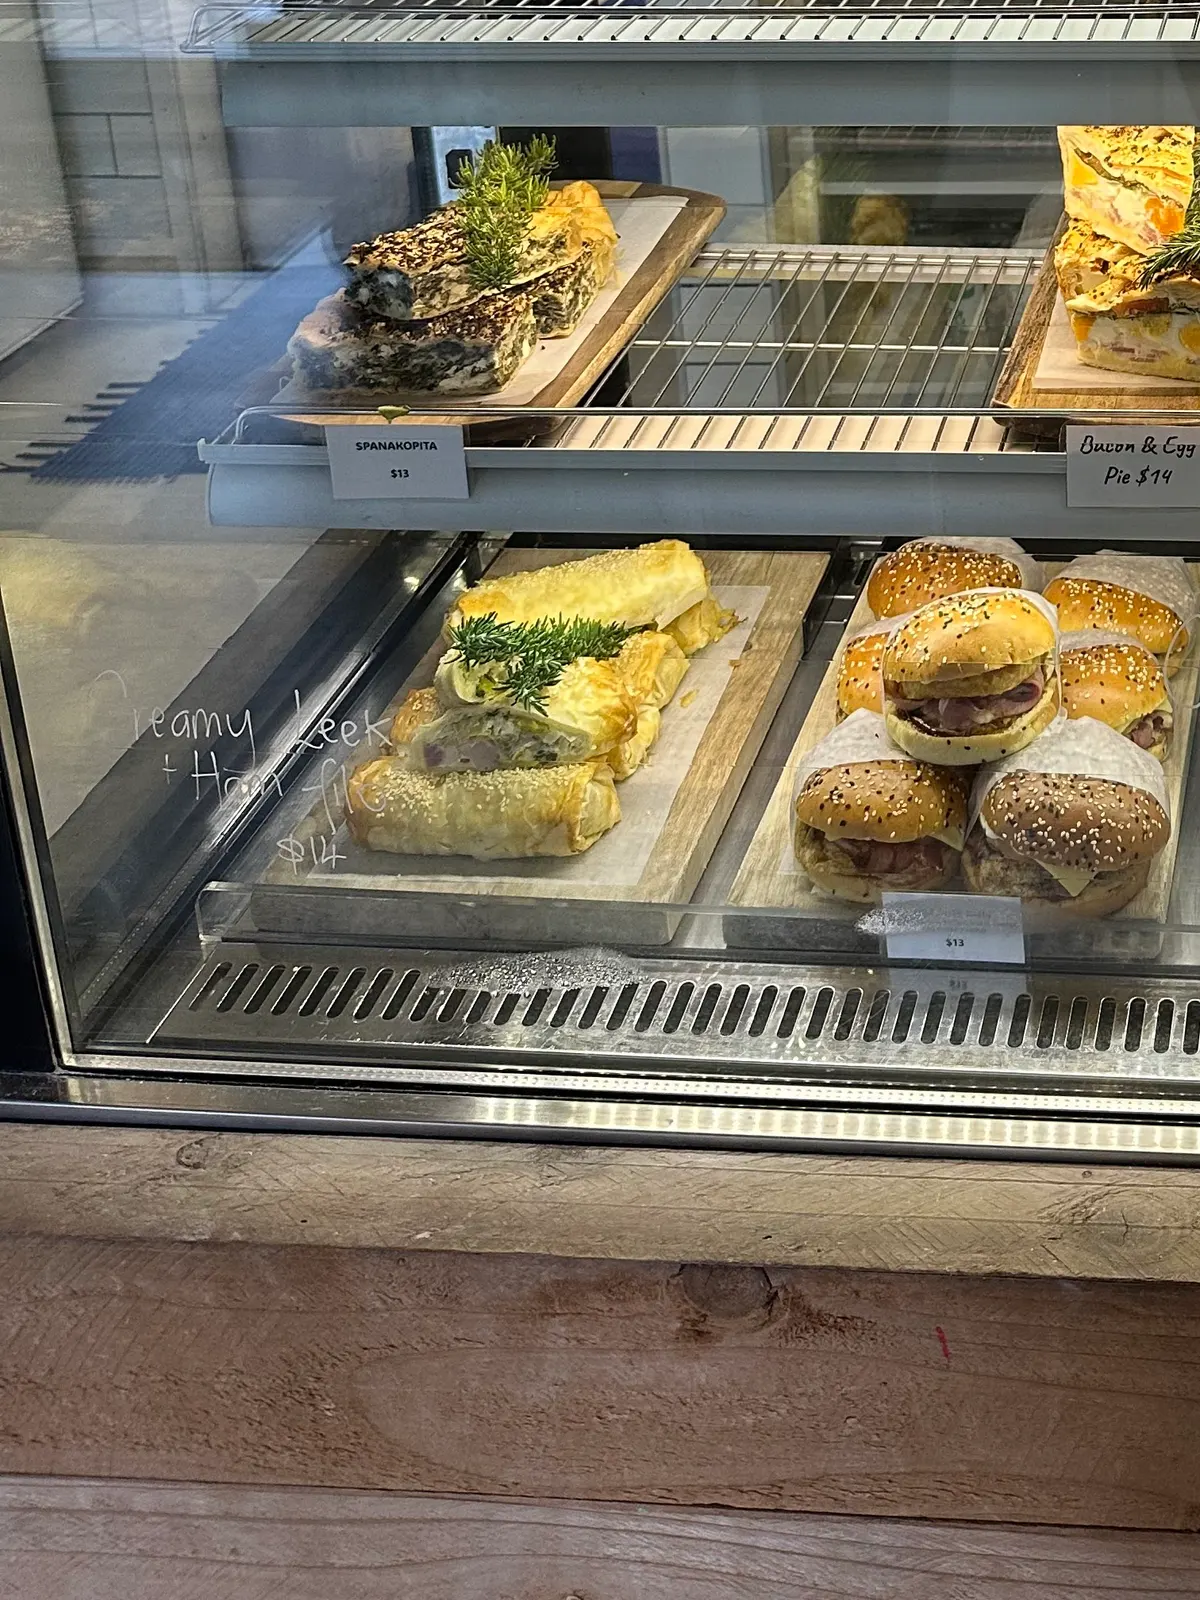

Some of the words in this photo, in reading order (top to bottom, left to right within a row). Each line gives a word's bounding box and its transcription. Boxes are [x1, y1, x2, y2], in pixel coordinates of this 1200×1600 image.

[355, 441, 438, 451] SPANAKOPITA
[1141, 436, 1158, 456] &
[1162, 436, 1196, 459] Egg
[390, 468, 410, 479] $13
[1104, 466, 1131, 485] Pie
[1135, 465, 1173, 487] $14
[294, 689, 393, 750] Leek
[161, 752, 178, 785] +
[276, 832, 347, 876] $14
[945, 938, 964, 948] $13
